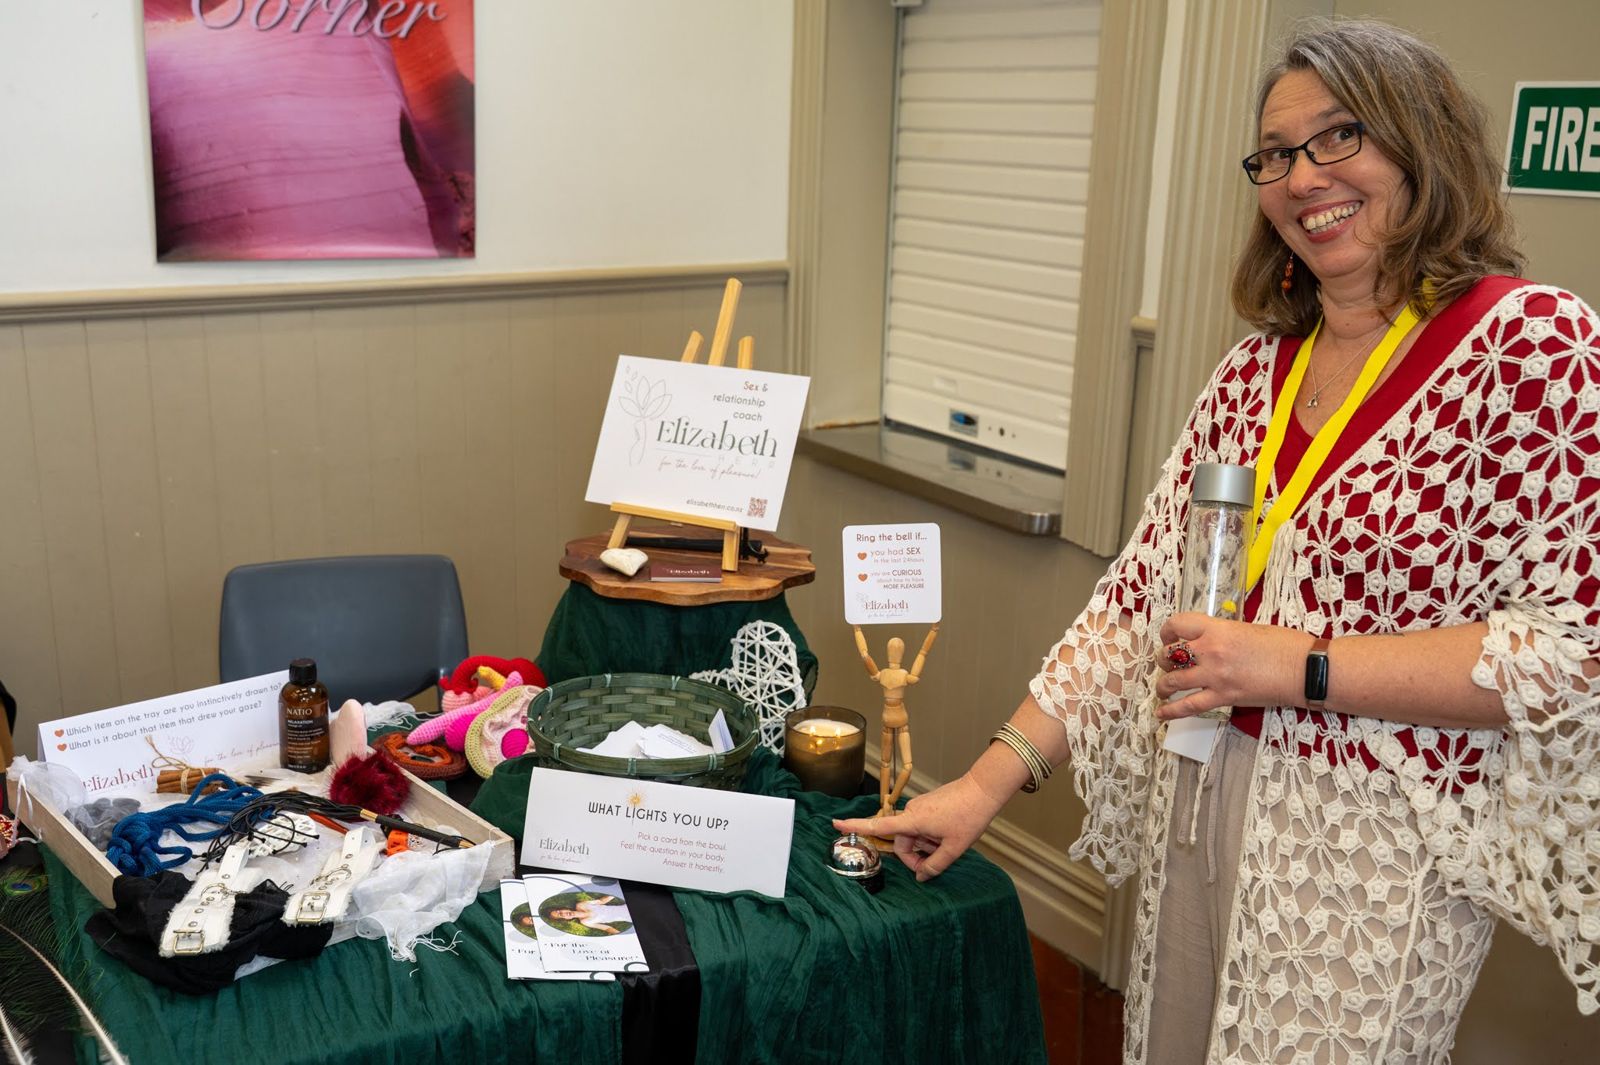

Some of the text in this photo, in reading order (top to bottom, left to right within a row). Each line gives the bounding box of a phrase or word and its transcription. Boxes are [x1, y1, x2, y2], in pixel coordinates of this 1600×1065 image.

[1521, 106, 1600, 173] FIRE
[743, 381, 769, 392] Sex &
[713, 393, 766, 408] relationship
[732, 411, 763, 422] coach
[656, 417, 778, 457] Elizabeth
[856, 533, 876, 543] Ring
[879, 533, 893, 541] the
[896, 532, 913, 541] bell
[870, 547, 921, 558] you had SEX
[865, 599, 909, 610] Elizabeth
[66, 726, 92, 736] Which
[95, 720, 112, 730] item
[128, 714, 141, 723] the
[144, 711, 160, 719] tray
[163, 707, 177, 715] are
[180, 703, 195, 713] you
[197, 693, 242, 707] instinctively
[245, 685, 268, 697] drawn
[286, 708, 313, 716] NATIO
[69, 740, 91, 750] What
[94, 737, 101, 745] is
[112, 730, 137, 740] about
[140, 725, 157, 734] that
[159, 720, 177, 730] item
[178, 716, 196, 726] that
[197, 712, 217, 721] drew
[219, 707, 236, 718] your
[238, 700, 262, 713] gaze?
[83, 764, 154, 792] Elizabeth
[588, 801, 729, 830] WHAT LIGHTS YOU UP?
[539, 837, 590, 855] Elizabeth
[638, 832, 651, 841] Pick
[661, 836, 678, 844] card
[680, 838, 694, 846] from
[696, 840, 707, 849] the
[620, 841, 634, 849] Feel
[636, 843, 647, 851] the
[649, 846, 679, 856] question
[689, 852, 704, 861] your
[663, 859, 687, 868] Answer
